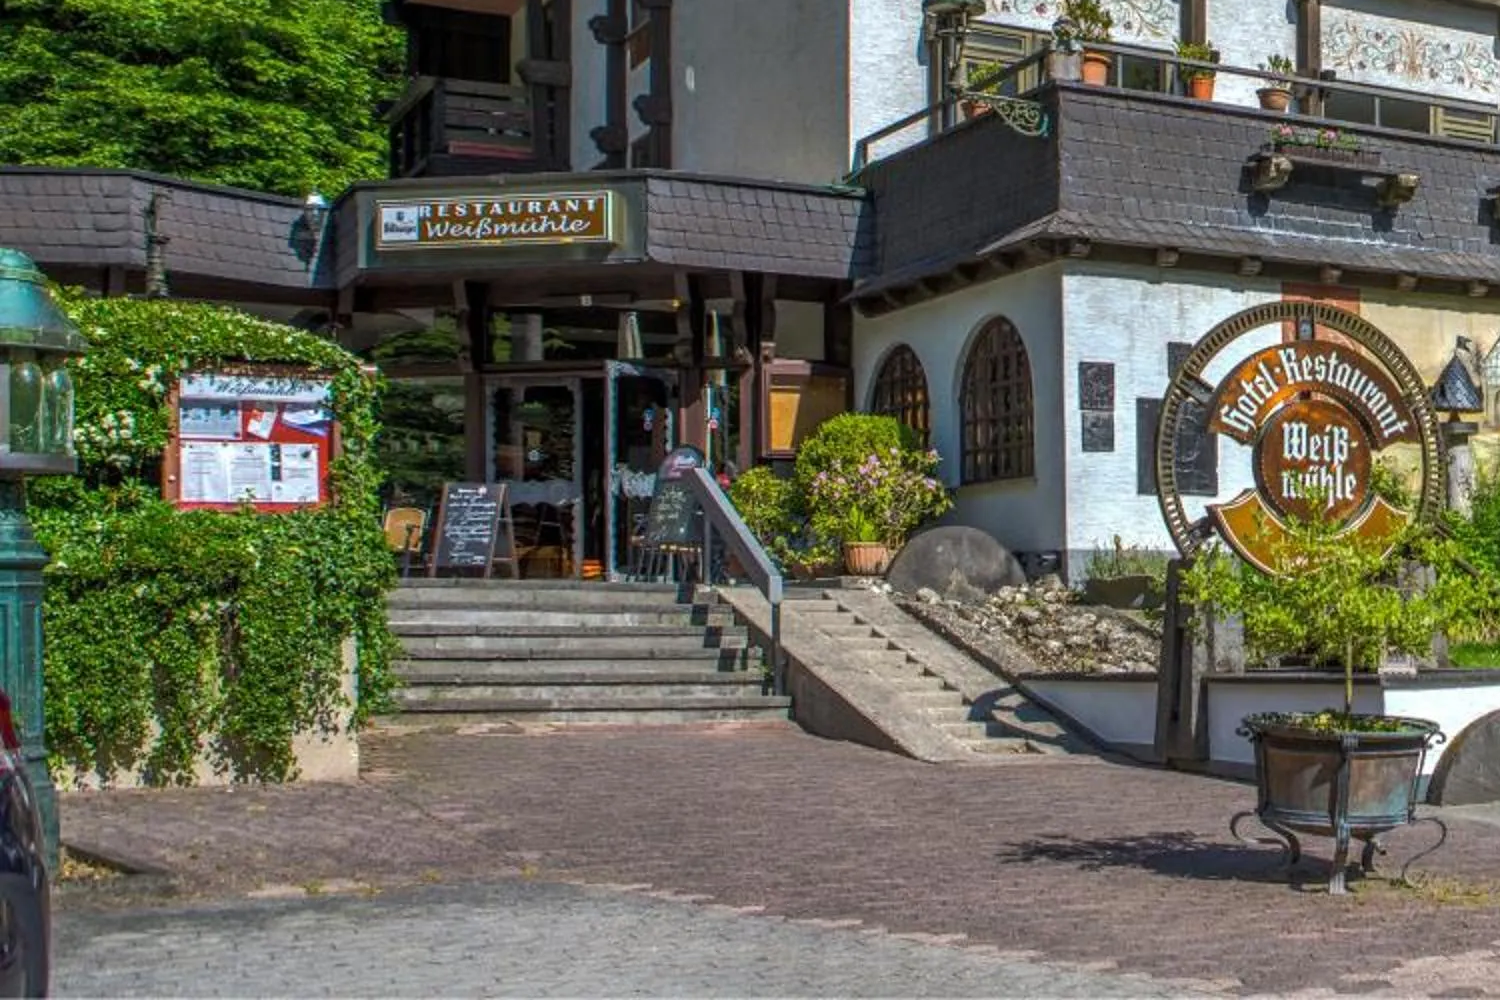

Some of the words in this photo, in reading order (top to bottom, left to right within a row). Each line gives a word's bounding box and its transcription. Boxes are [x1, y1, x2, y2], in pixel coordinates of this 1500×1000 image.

[418, 199, 598, 218] RESTAURANT
[426, 214, 591, 239] Weißmühle
[1281, 464, 1357, 508] mühle
